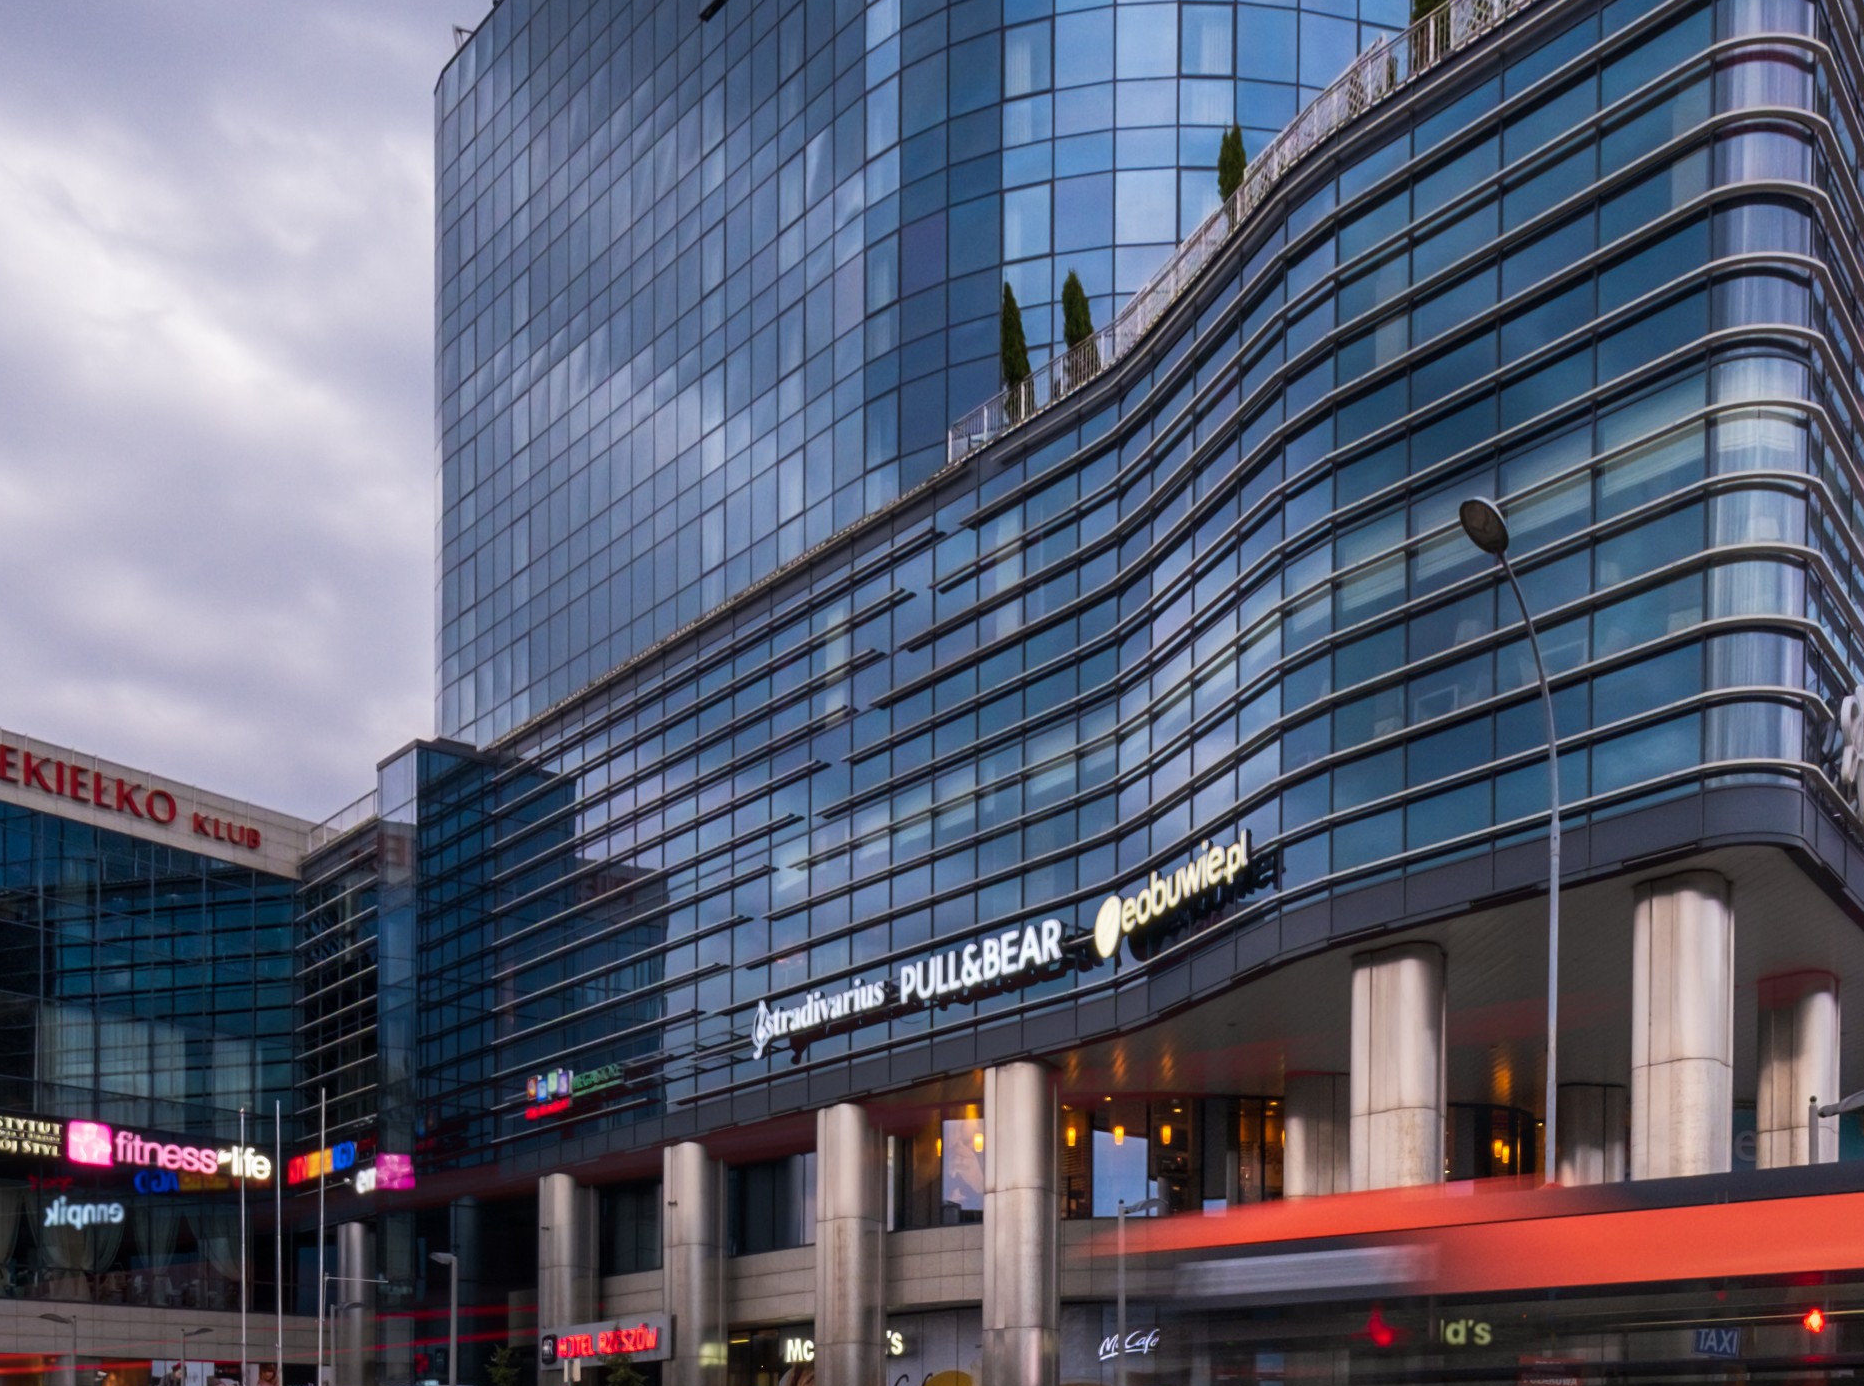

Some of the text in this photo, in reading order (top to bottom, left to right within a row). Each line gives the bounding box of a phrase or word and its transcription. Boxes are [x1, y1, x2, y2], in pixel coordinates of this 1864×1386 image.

[192, 811, 261, 849] KLUB
[900, 919, 1063, 1004] PULL&BEAR
[1121, 829, 1249, 933] eobuwie.pl
[115, 1131, 218, 1175] fitness
[231, 1146, 271, 1180] life
[557, 1333, 596, 1358] HOTEL
[1698, 1329, 1737, 1355] TAXI
